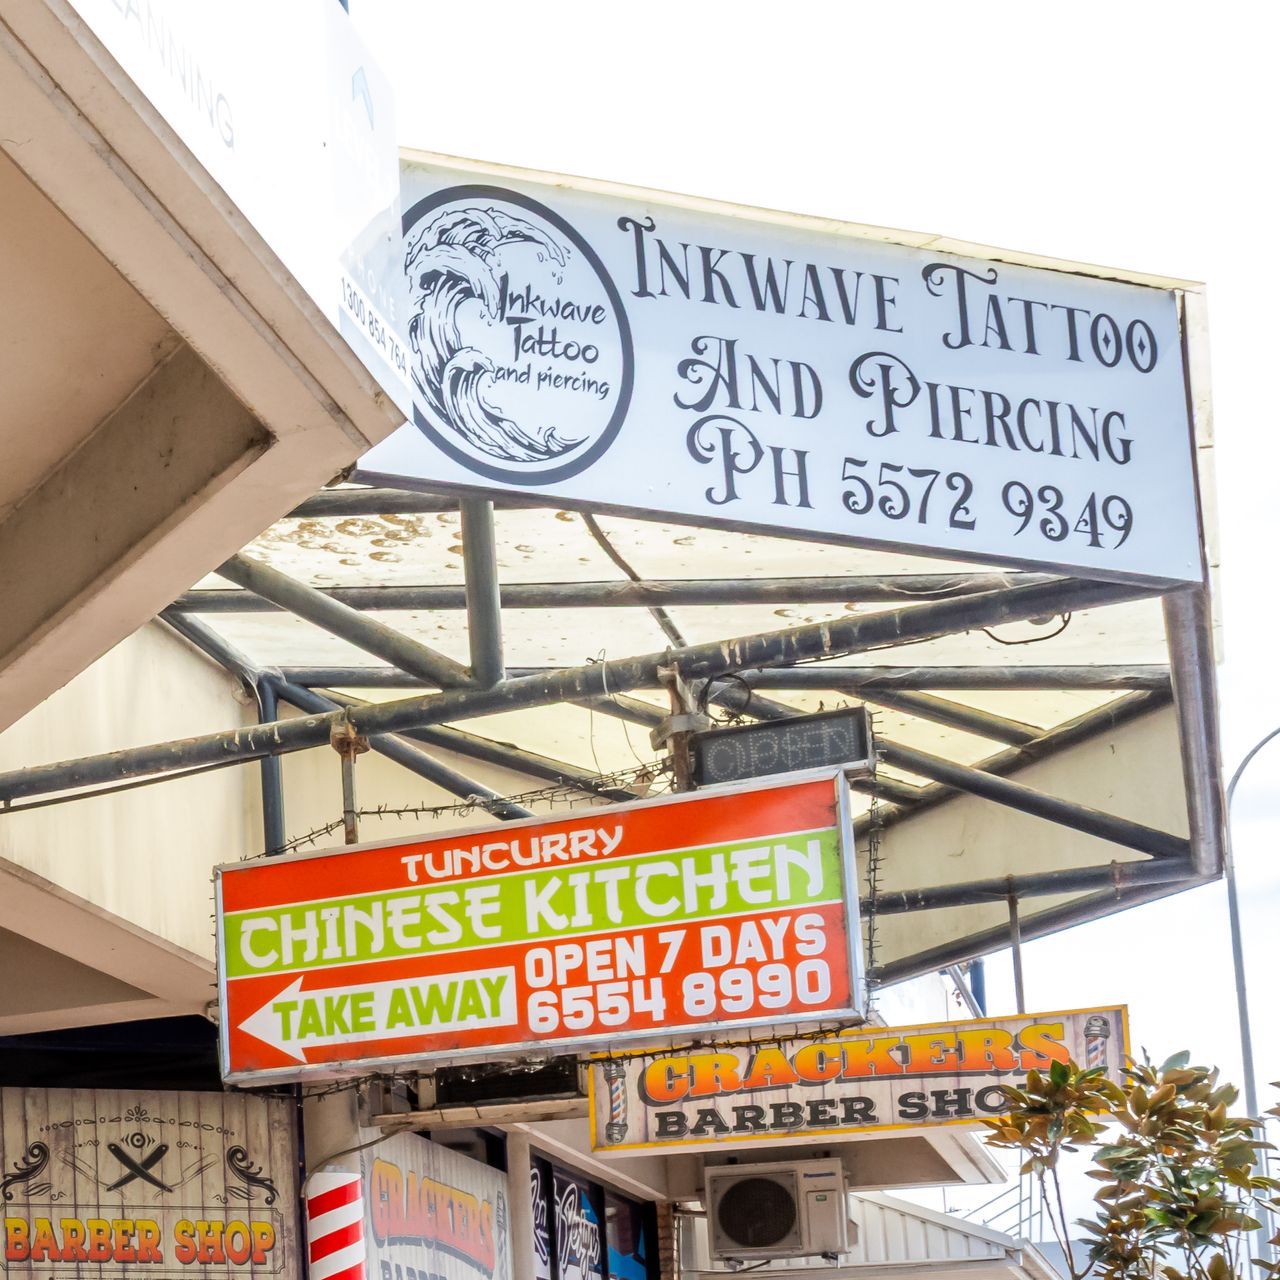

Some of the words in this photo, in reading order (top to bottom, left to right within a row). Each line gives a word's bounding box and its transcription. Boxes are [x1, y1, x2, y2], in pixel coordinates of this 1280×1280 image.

[341, 277, 366, 326] 1300
[368, 309, 387, 350] 854
[389, 336, 407, 376] 764
[497, 275, 608, 326] Inkwave
[506, 318, 601, 365] Tattoo
[495, 362, 532, 385] and
[536, 368, 611, 400] piercing
[840, 457, 978, 531] 5572
[1000, 480, 1134, 550] 9349
[401, 825, 624, 882] TUNCURRY
[240, 882, 503, 969] CHINESE
[524, 840, 824, 934] KITCHEN
[525, 936, 646, 988] OPEN
[657, 935, 685, 974] 7
[702, 914, 827, 968] DAYS
[272, 988, 376, 1041] TAKE
[385, 975, 509, 1031] AWAY
[526, 976, 665, 1036] 6554
[684, 957, 831, 1016] 8990
[639, 1022, 1071, 1106] CRACKERS
[655, 1095, 877, 1141] BARBER
[896, 1083, 1028, 1121] SHO
[4, 1216, 164, 1264] BARBER
[173, 1219, 276, 1266] SHOP
[370, 1156, 496, 1280] CRACKERS
